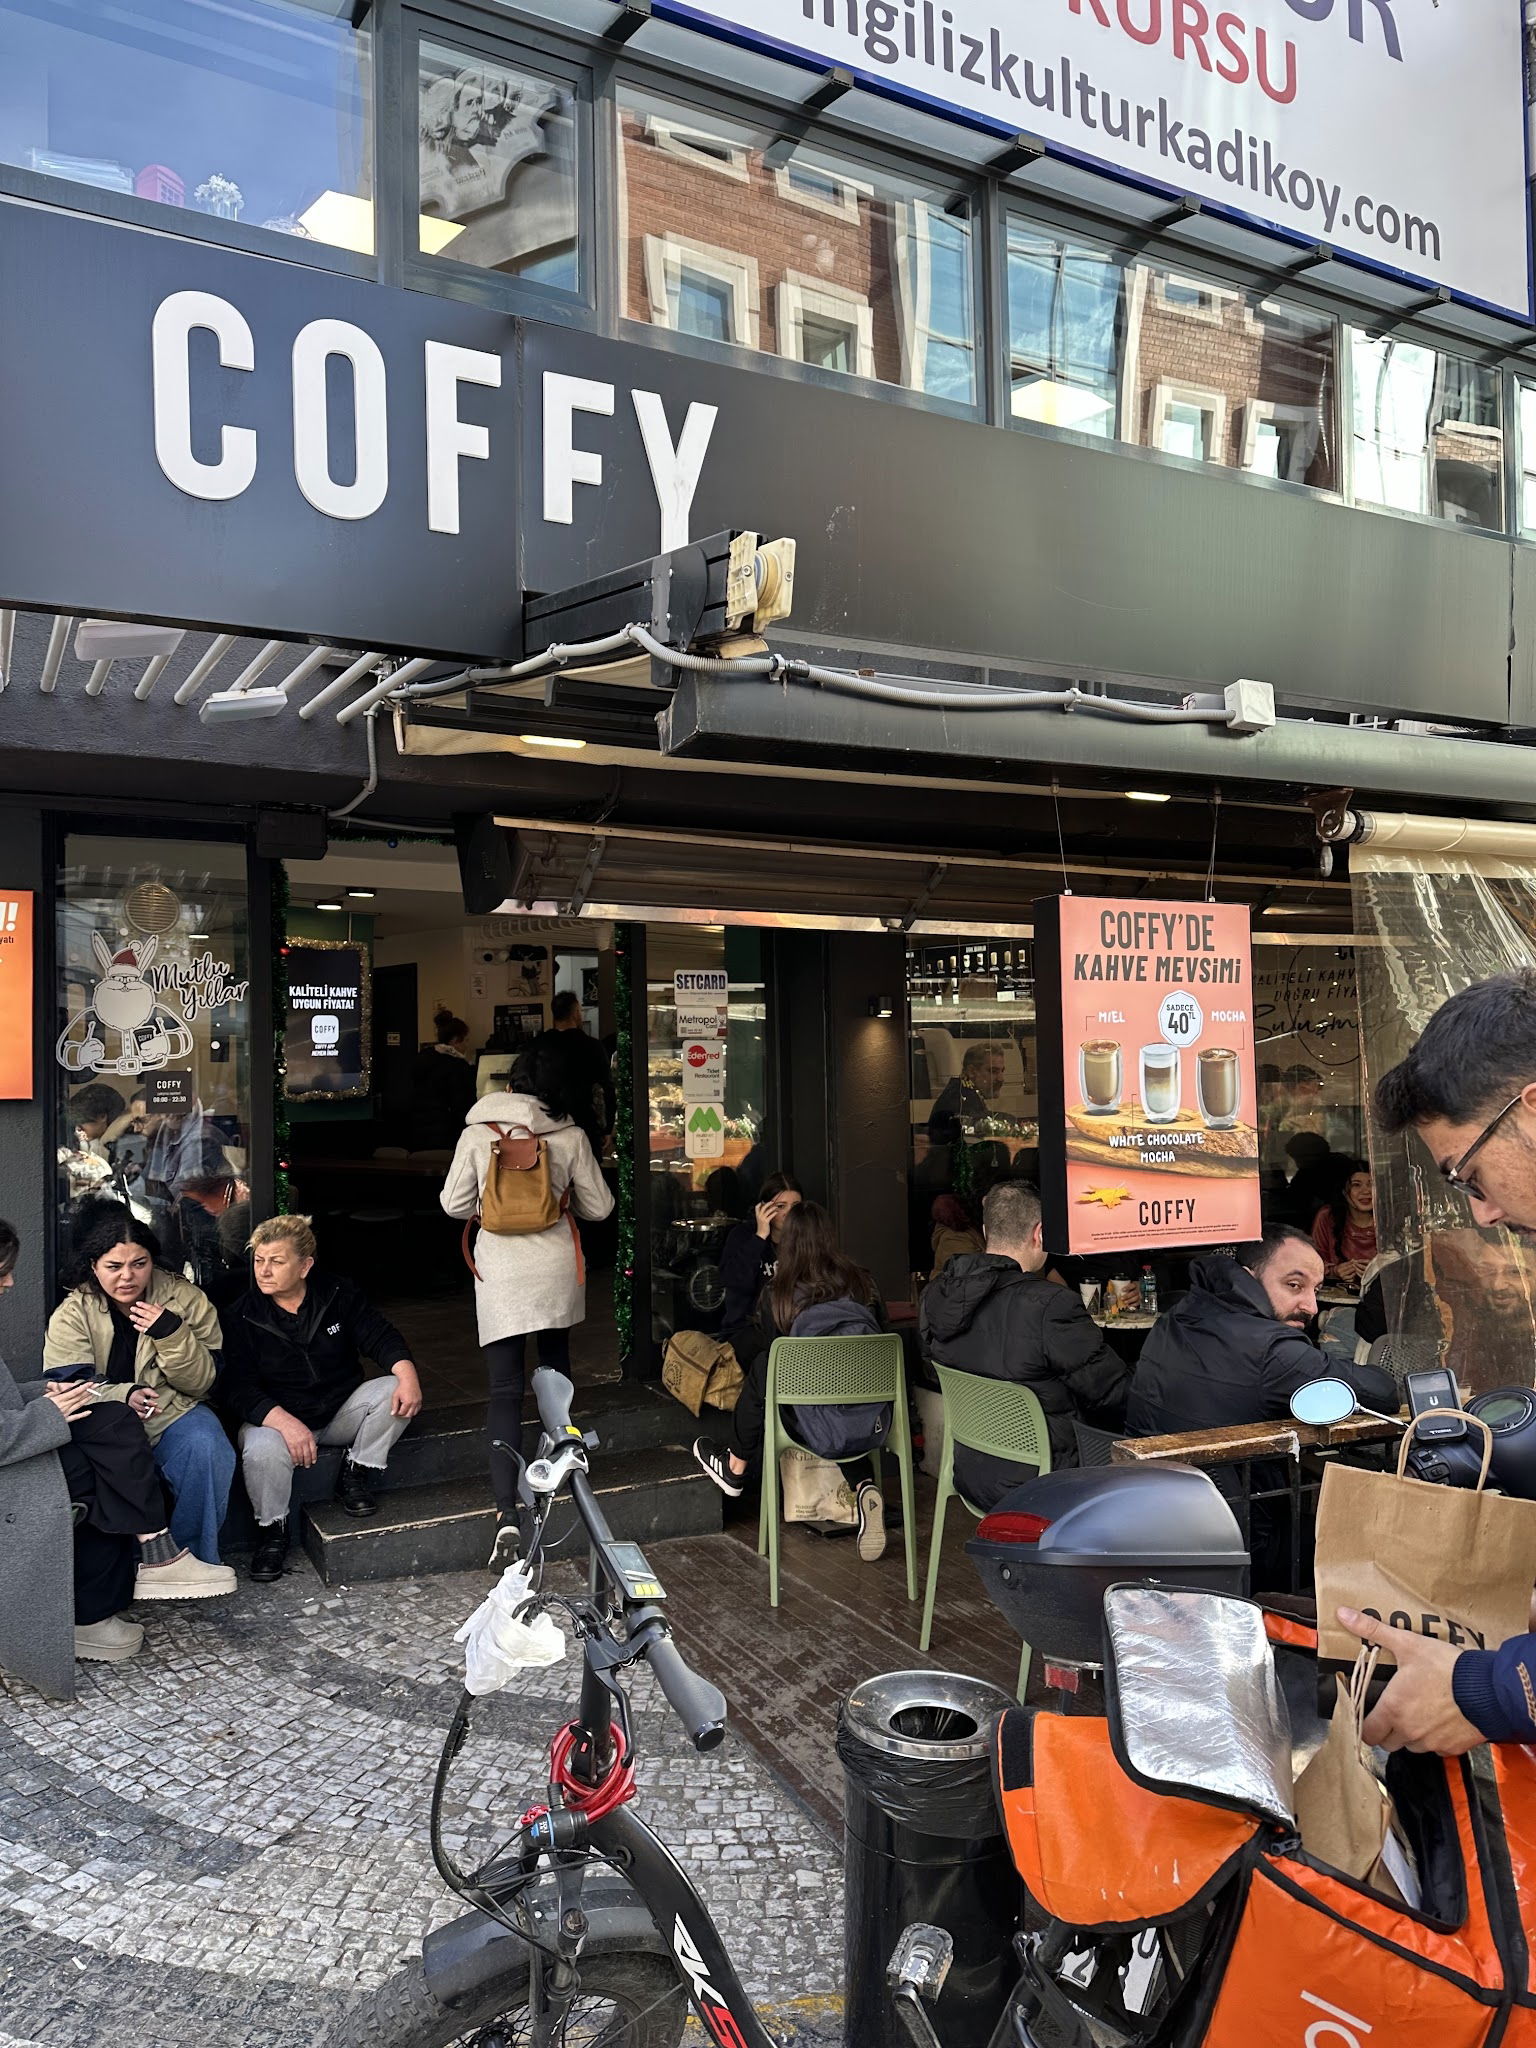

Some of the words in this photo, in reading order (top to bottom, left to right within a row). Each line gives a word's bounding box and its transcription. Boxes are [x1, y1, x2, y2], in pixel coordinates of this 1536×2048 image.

[152, 290, 718, 556] COFFY
[151, 952, 230, 993] Mutlu
[1074, 954, 1148, 982] KAHVE
[676, 974, 726, 990] SETCARD
[289, 984, 328, 997] KALİTELİ
[329, 987, 358, 997] KAHVE
[292, 999, 321, 1009] UYGUN
[1166, 1004, 1194, 1012] SADECE
[679, 1015, 717, 1025] Metropol
[1212, 1011, 1246, 1022] MOCHA
[1168, 1012, 1189, 1034] 40
[314, 1025, 336, 1034] COFFY
[688, 1052, 720, 1060] Edenred
[156, 1081, 181, 1089] COFFY
[1109, 1134, 1145, 1147] WHITE
[1147, 1132, 1205, 1145] CHOCOLATE
[1140, 1151, 1176, 1163] MOCHA
[1139, 1199, 1195, 1225] COFFY
